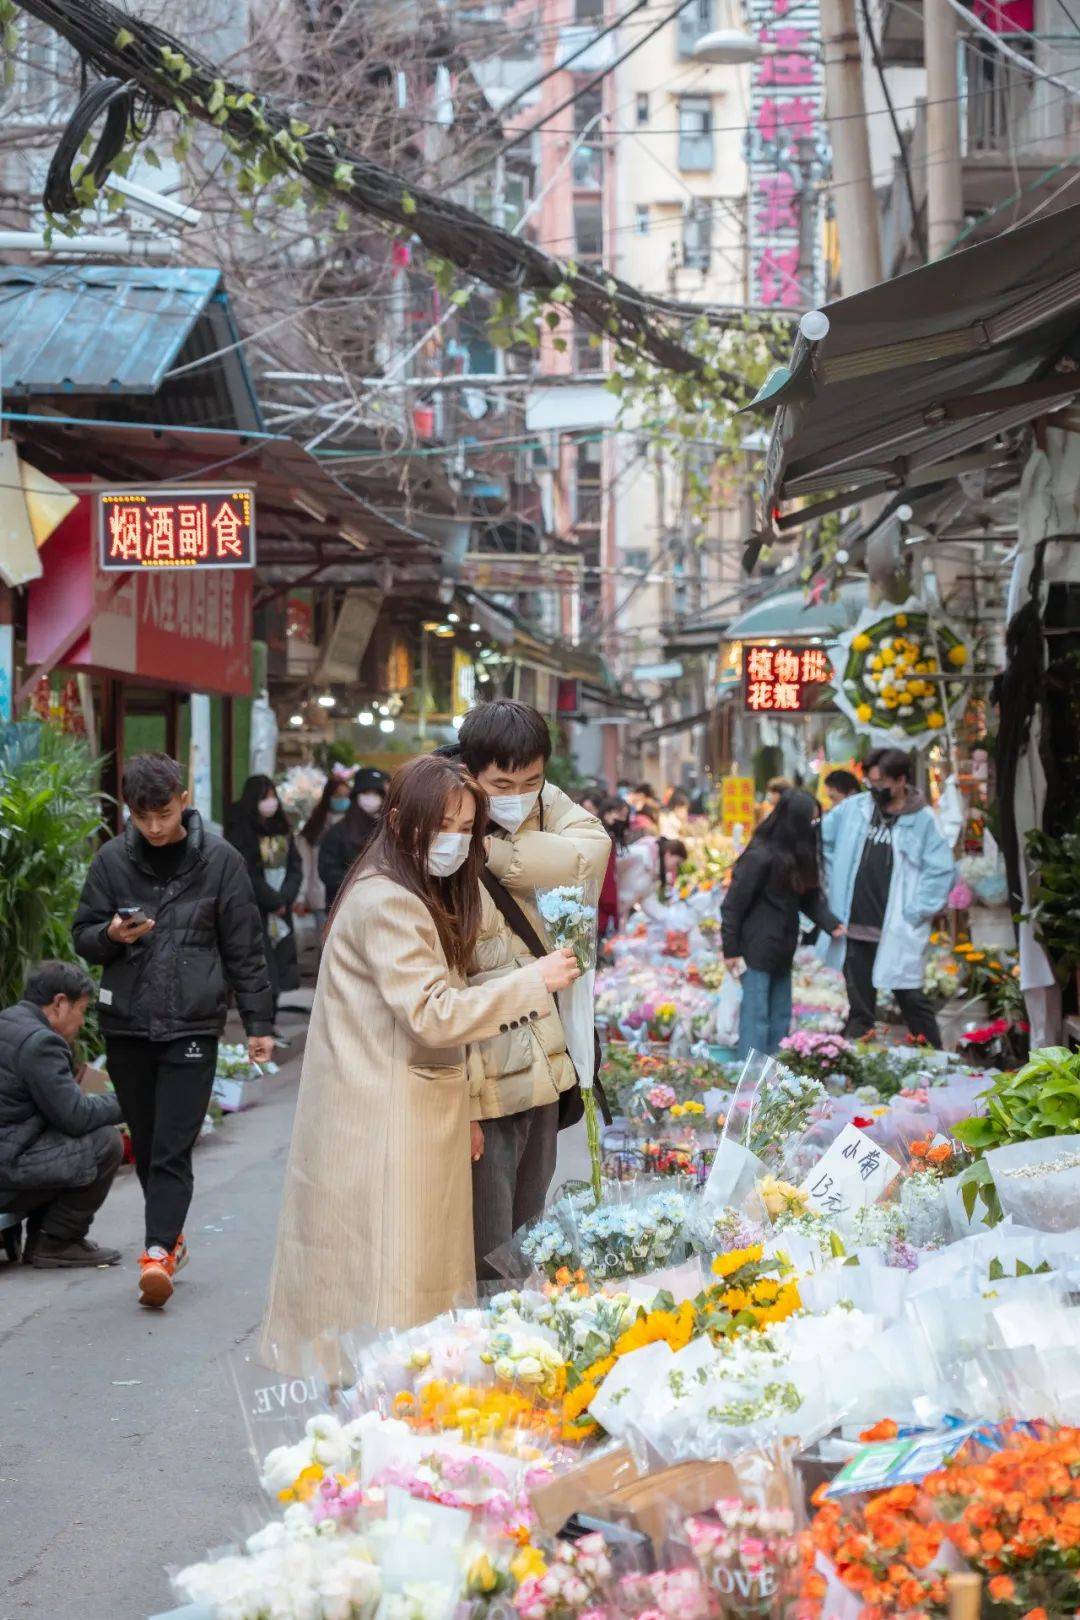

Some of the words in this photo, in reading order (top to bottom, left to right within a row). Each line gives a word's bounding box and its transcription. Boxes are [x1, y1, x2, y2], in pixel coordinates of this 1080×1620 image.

[109, 503, 243, 559] 烟酒副食
[748, 648, 834, 682] 植物批
[748, 682, 800, 710] 花瓶
[810, 1173, 850, 1213] 13元
